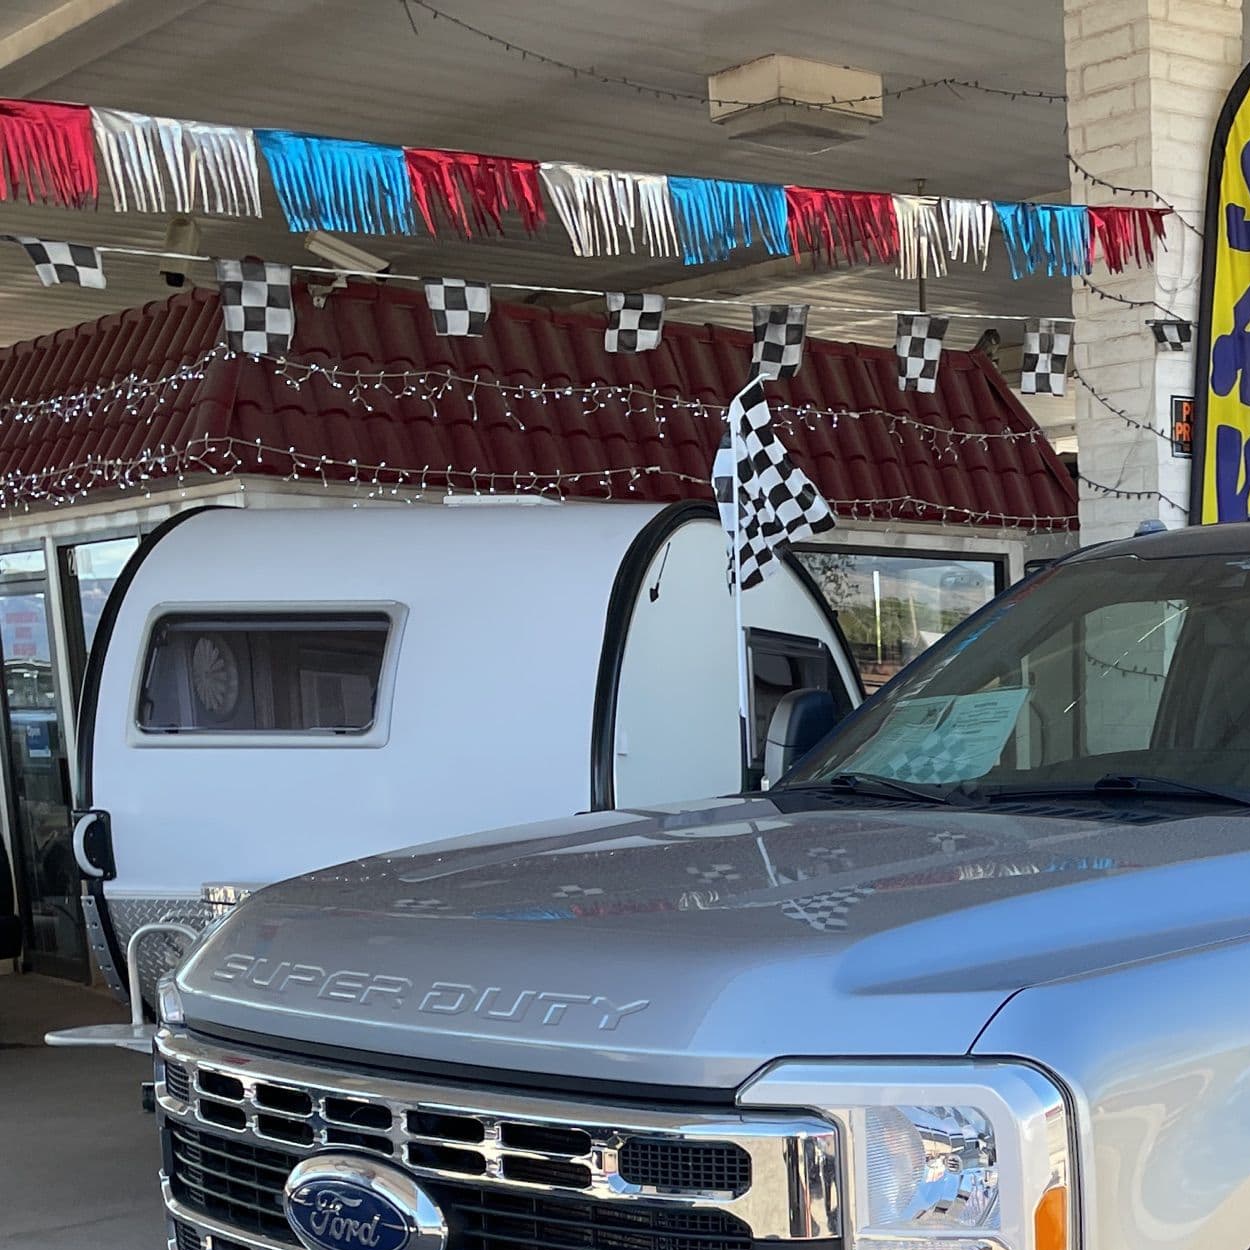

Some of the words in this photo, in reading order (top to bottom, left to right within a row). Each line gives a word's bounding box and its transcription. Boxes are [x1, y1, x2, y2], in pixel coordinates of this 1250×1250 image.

[213, 953, 412, 1008] SUPER
[418, 982, 649, 1030] DUTY
[310, 1190, 380, 1247] Ford
